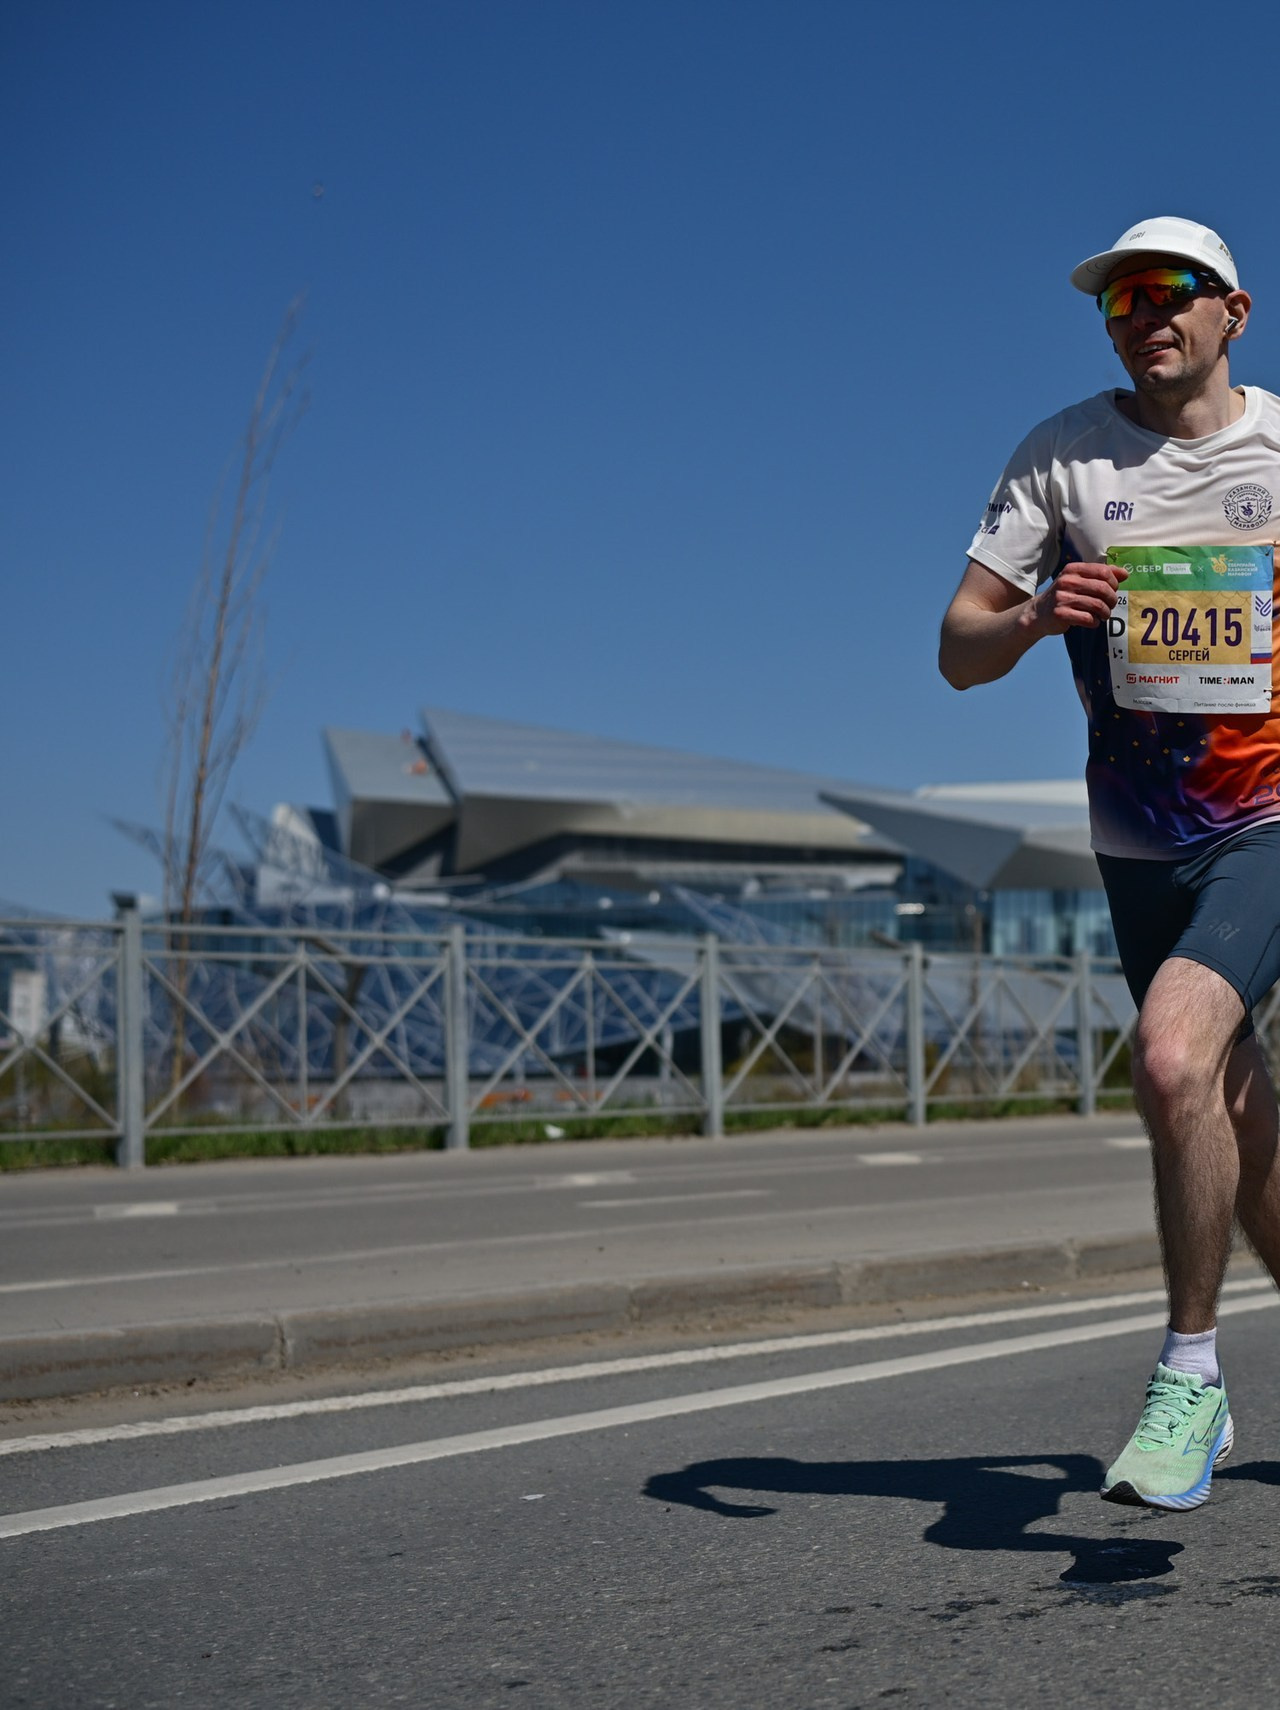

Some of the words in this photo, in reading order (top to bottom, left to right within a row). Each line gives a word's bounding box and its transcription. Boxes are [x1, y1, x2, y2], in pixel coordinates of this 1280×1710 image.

[1104, 501, 1135, 521] GRi
[1233, 519, 1264, 529] МАРАФОН
[1136, 565, 1161, 573] СБЕР
[1109, 616, 1126, 637] D
[1141, 607, 1243, 647] 20415
[1168, 648, 1210, 661] СЕРГЕЙ
[1138, 675, 1180, 684] МАГНИТ
